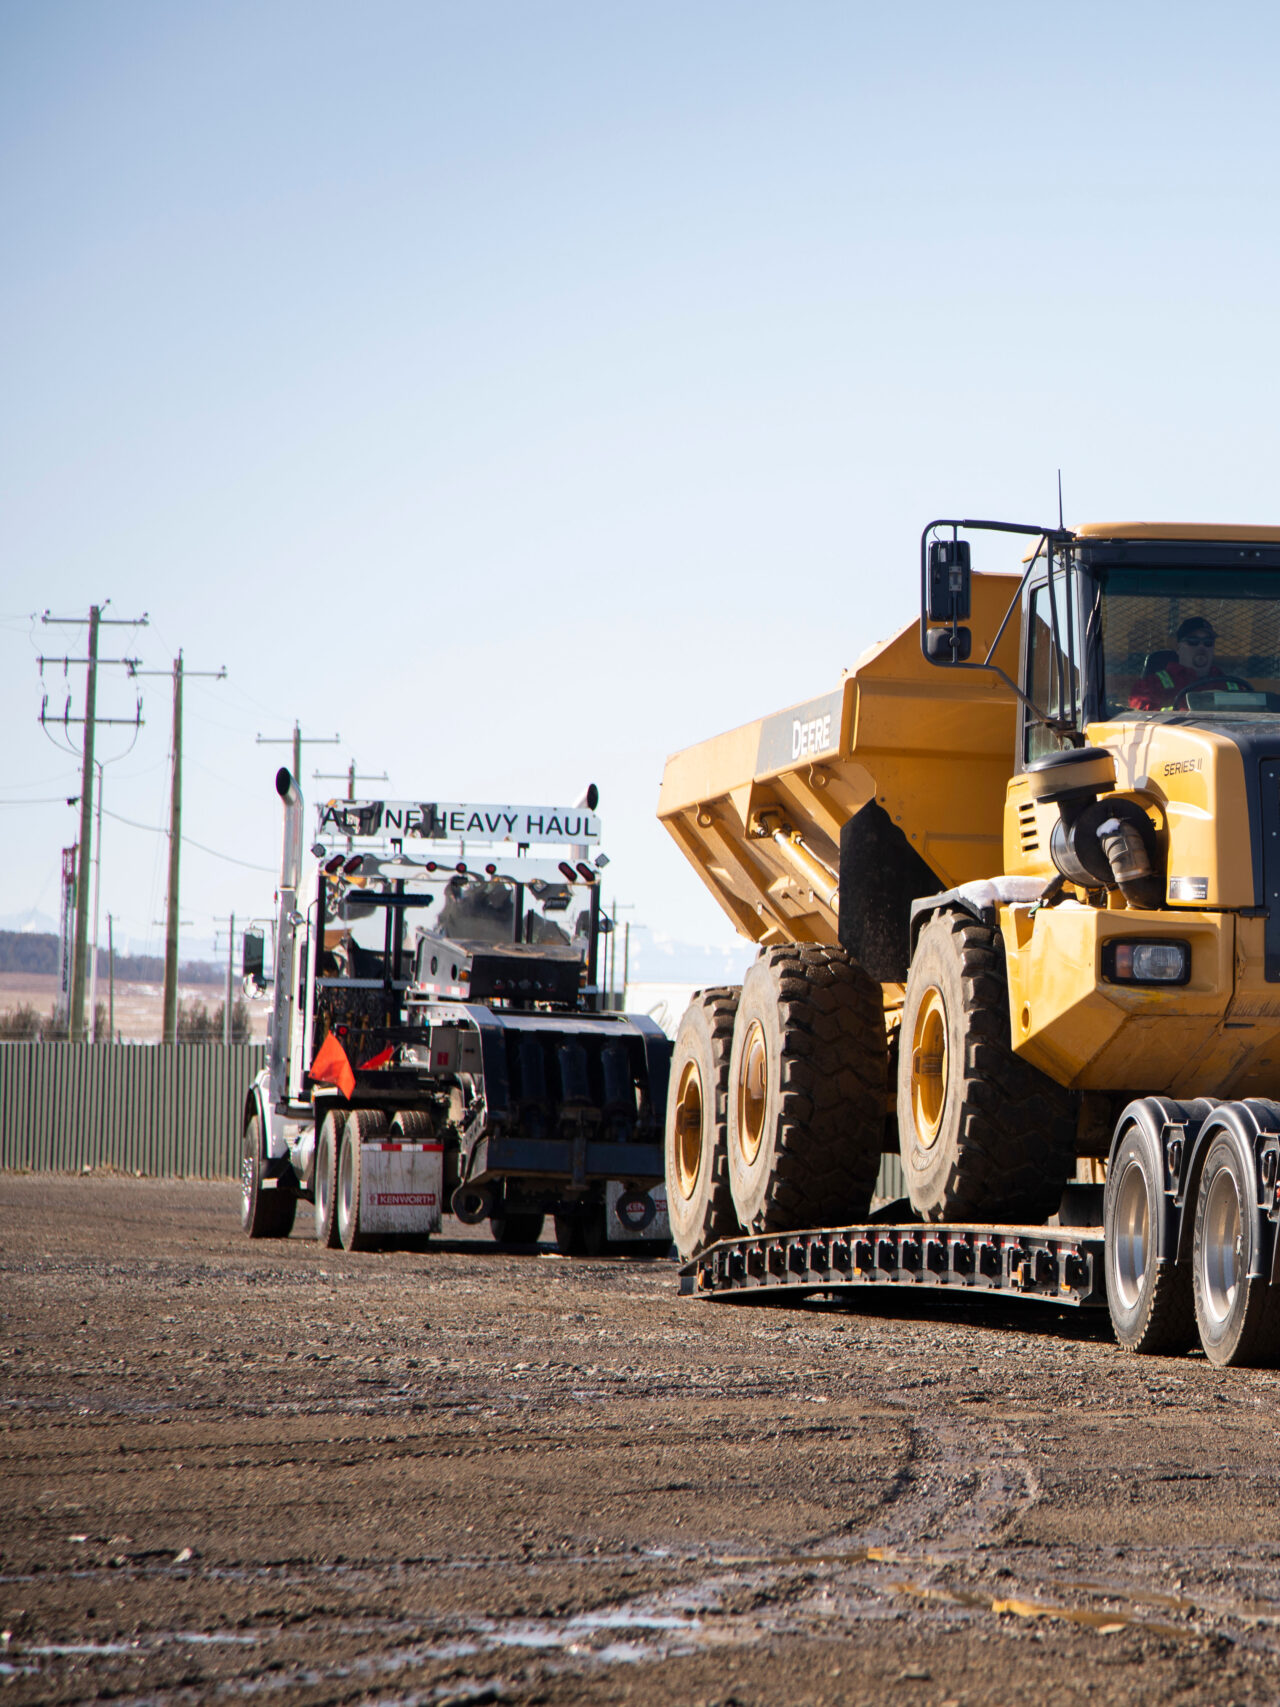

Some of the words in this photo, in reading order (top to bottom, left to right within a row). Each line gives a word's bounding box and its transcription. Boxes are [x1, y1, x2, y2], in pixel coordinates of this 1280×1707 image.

[791, 713, 831, 760] DEERE
[1164, 759, 1195, 777] SERIES
[1197, 757, 1203, 771] II
[321, 807, 422, 830] ALPINE
[430, 810, 518, 833] HEAVY
[526, 815, 598, 837] HAUL
[380, 1194, 434, 1204] KENWORTH
